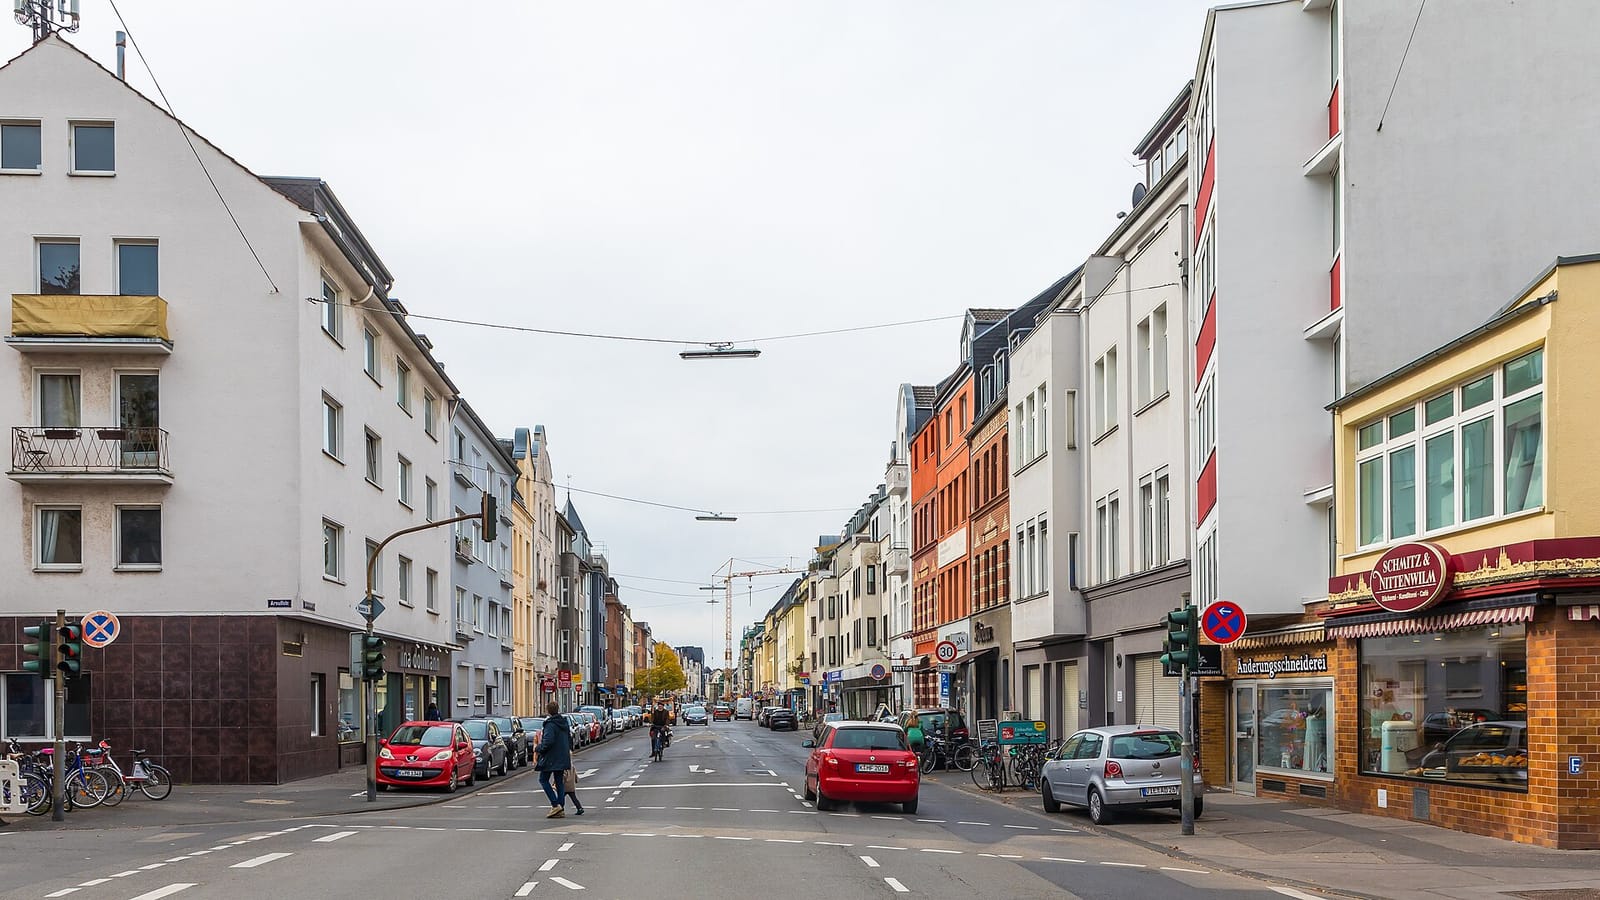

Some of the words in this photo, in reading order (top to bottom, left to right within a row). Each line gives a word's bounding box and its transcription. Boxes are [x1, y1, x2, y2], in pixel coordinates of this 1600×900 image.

[1382, 554, 1422, 573] SCHMITZ
[1423, 552, 1431, 567] &
[1373, 569, 1437, 590] NITTENWILM
[940, 647, 953, 657] 30
[1237, 654, 1327, 678] Änderungsschneiderei
